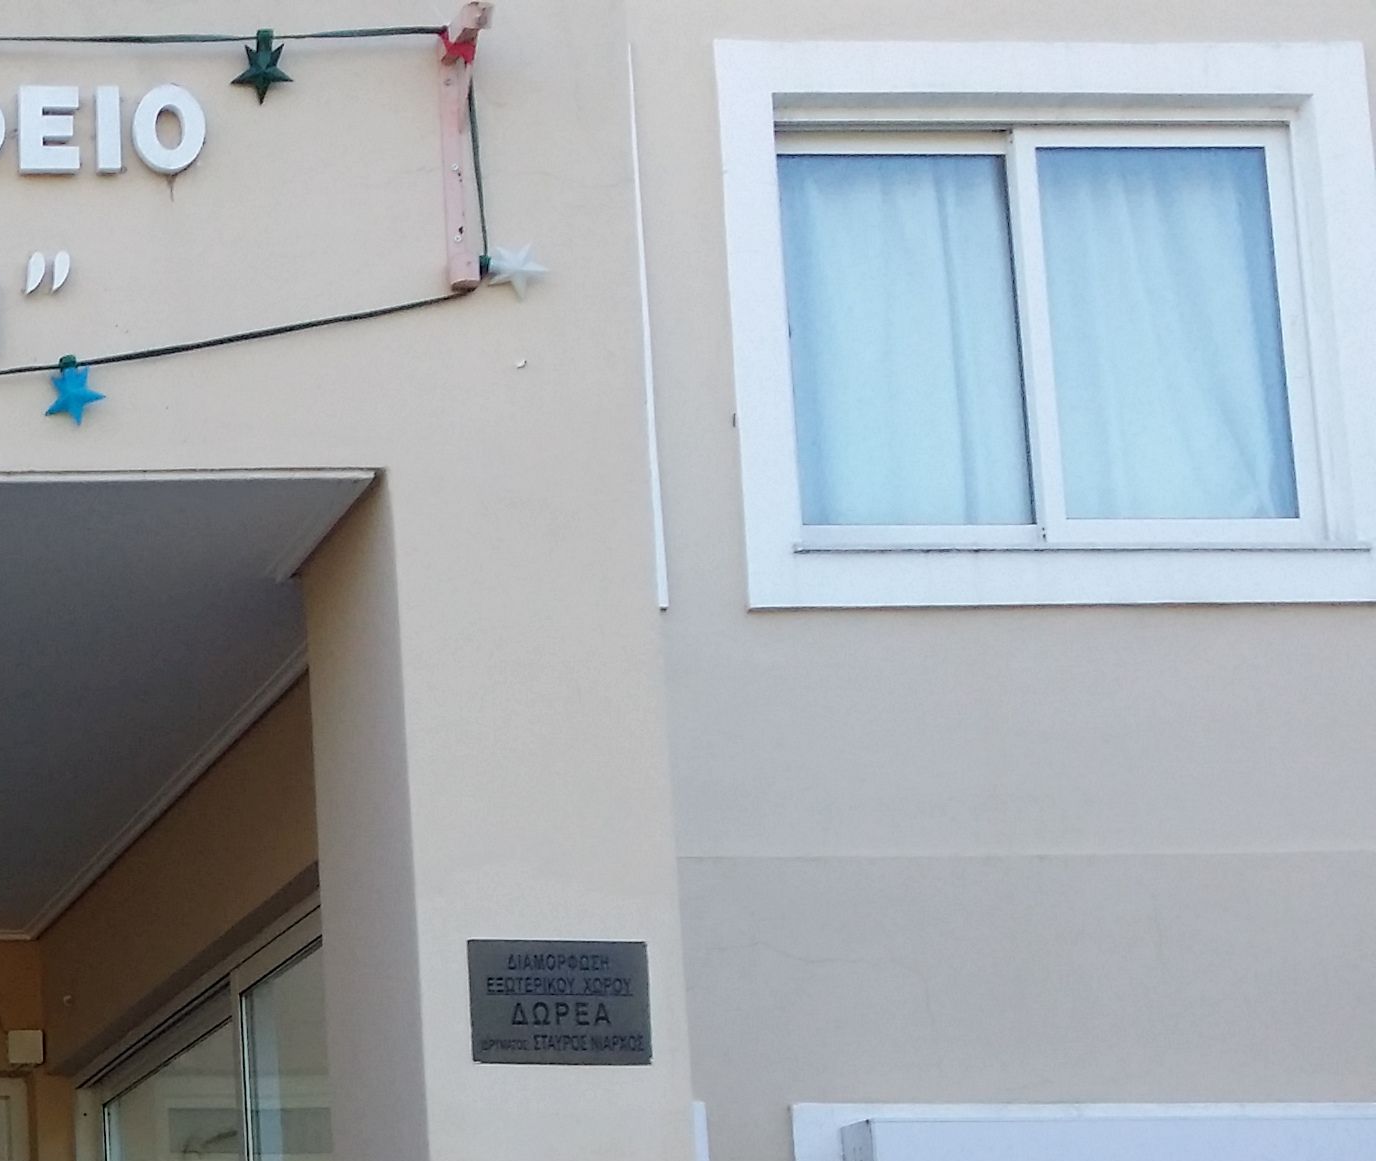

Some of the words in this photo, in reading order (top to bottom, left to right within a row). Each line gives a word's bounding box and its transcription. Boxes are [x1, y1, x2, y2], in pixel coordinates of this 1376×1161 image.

[508, 954, 610, 971] ΔΙΑΜΟΡΦΩΣΗ
[486, 976, 576, 994] ΕΞΩΤΕΡΙΚΟΥ
[512, 1001, 612, 1026] ΔΩΡΕΑ
